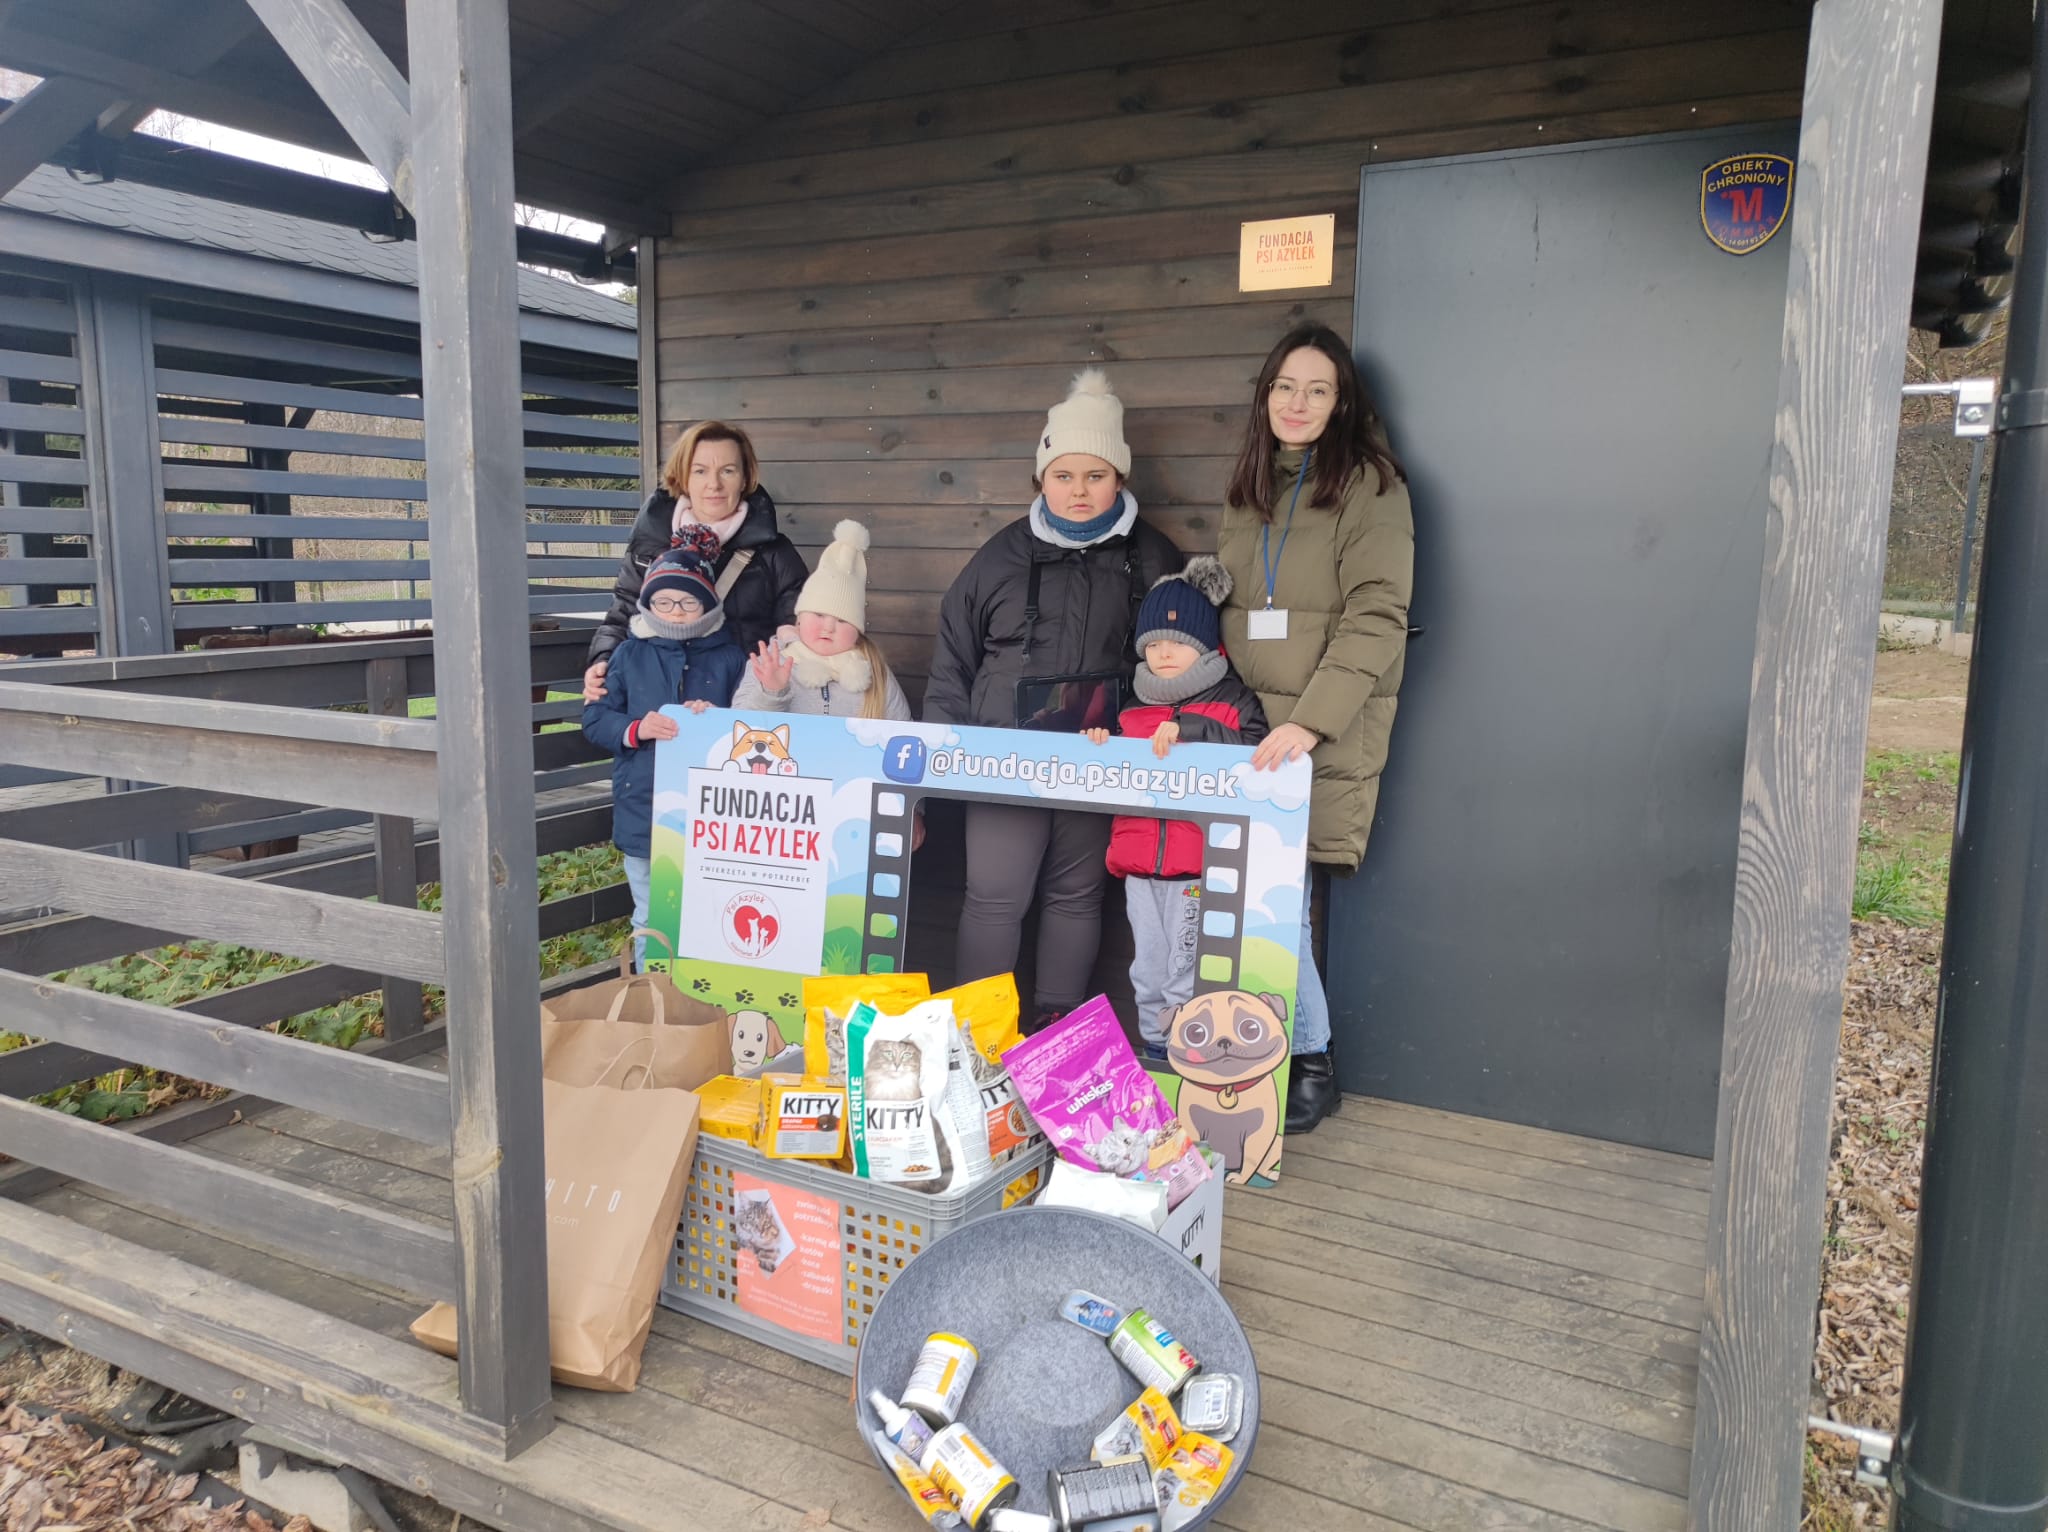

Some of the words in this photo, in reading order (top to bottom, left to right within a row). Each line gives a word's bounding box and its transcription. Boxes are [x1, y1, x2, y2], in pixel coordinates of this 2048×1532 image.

[1722, 160, 1773, 175] OBIEKT
[1707, 173, 1785, 192] CHRONIONY
[1259, 230, 1313, 248] FUNDACJA
[1256, 249, 1273, 264] PSI
[1277, 246, 1316, 262] AZYLEK
[929, 749, 1240, 800] @fundacja.psiazylek
[700, 785, 816, 825] FUNDACJA
[692, 819, 727, 851] PSI
[733, 823, 820, 861] AZYLEK
[762, 872, 811, 884] POTRZEBIE
[783, 1096, 840, 1115] KITTY
[980, 1076, 1012, 1109] ITT
[1065, 1078, 1115, 1115] whiskas
[850, 1075, 863, 1141] STERILE
[866, 1104, 924, 1130] KITTY
[1181, 1206, 1206, 1254] KITTY
